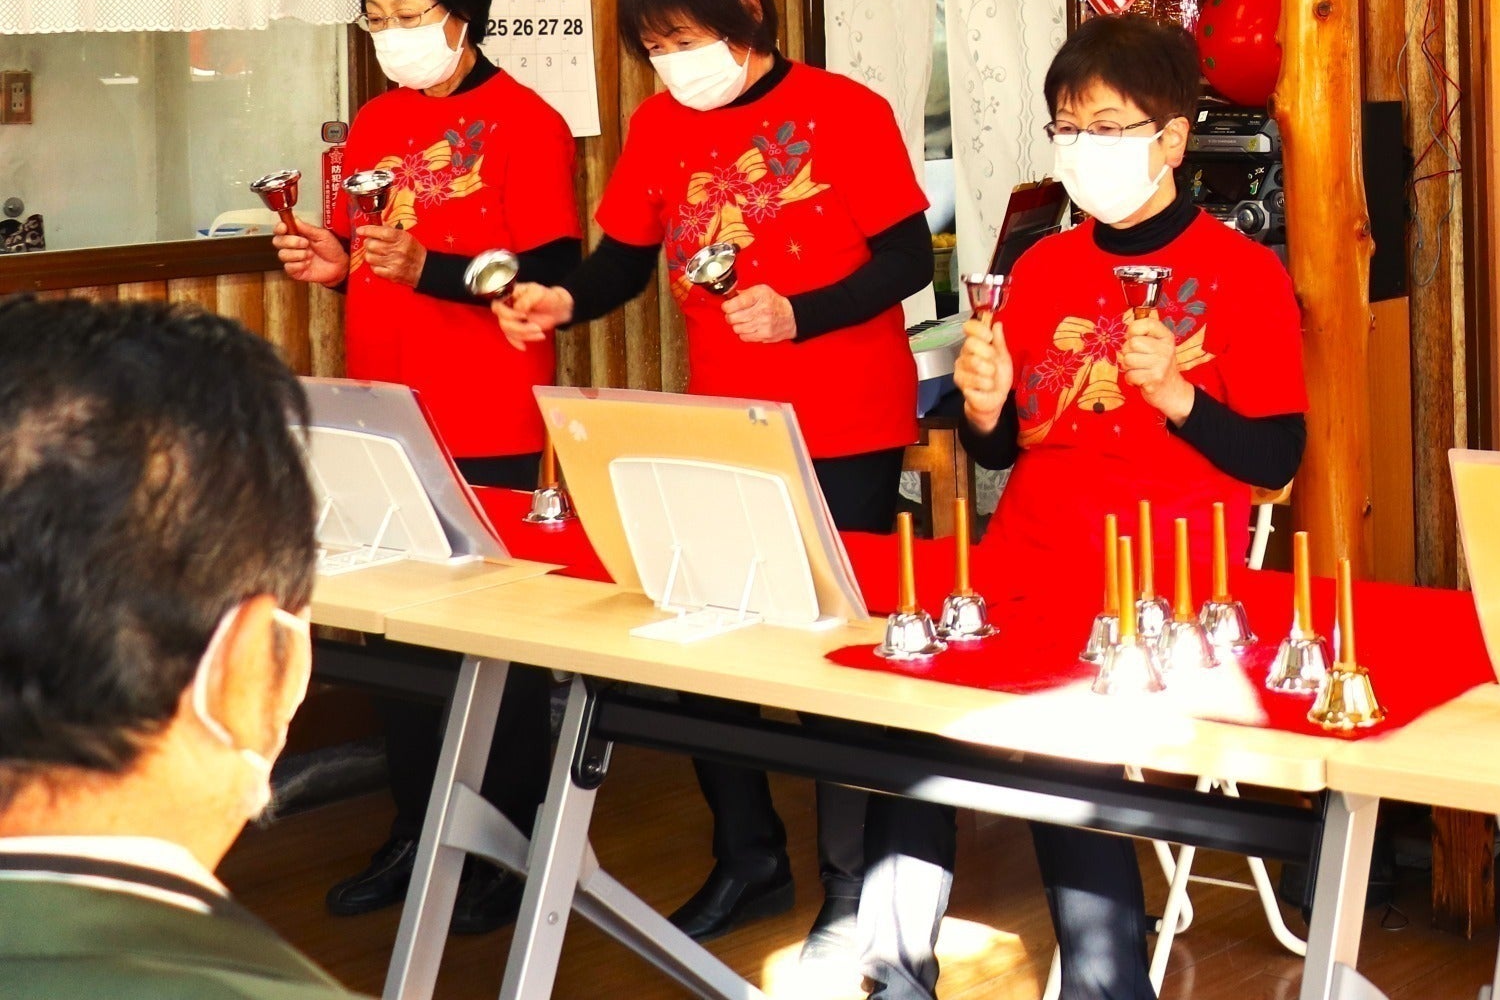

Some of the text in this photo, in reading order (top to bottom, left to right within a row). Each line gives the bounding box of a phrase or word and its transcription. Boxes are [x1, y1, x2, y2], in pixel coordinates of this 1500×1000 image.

[488, 19, 583, 36] 25 26 27 28
[520, 57, 528, 68] 2
[546, 57, 552, 67] 3
[571, 56, 577, 66] 4
